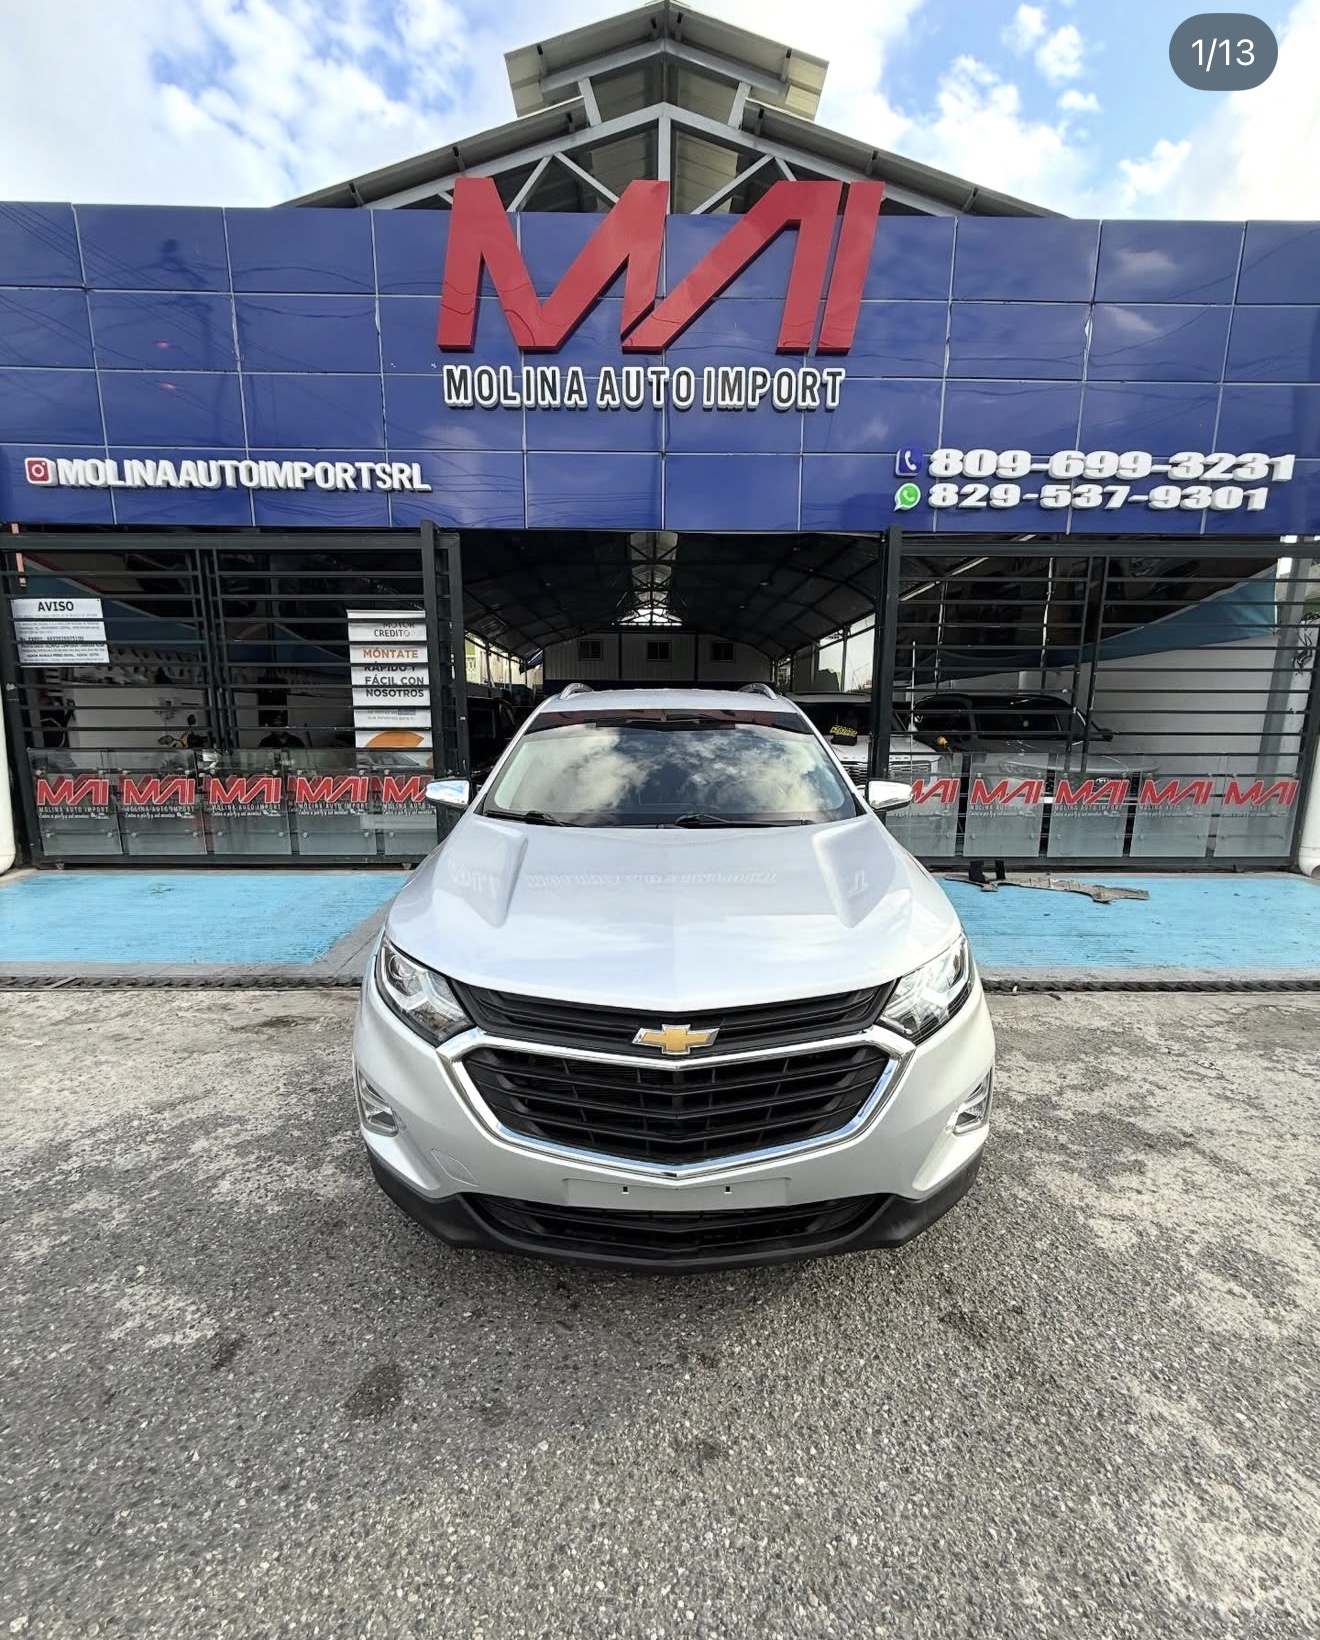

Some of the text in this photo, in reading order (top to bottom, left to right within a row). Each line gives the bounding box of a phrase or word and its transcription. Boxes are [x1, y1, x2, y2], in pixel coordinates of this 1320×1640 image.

[443, 364, 845, 410] MOLINA AUTO IMPORT
[56, 458, 432, 492] MOLINAAUTOIMPORTSRL
[928, 448, 1296, 482] 809-699-3231
[928, 482, 1268, 511] 829-537-9301
[38, 601, 74, 612] AVISO
[365, 674, 424, 686] FÁCIL CON
[366, 688, 424, 698] NOSOTROS
